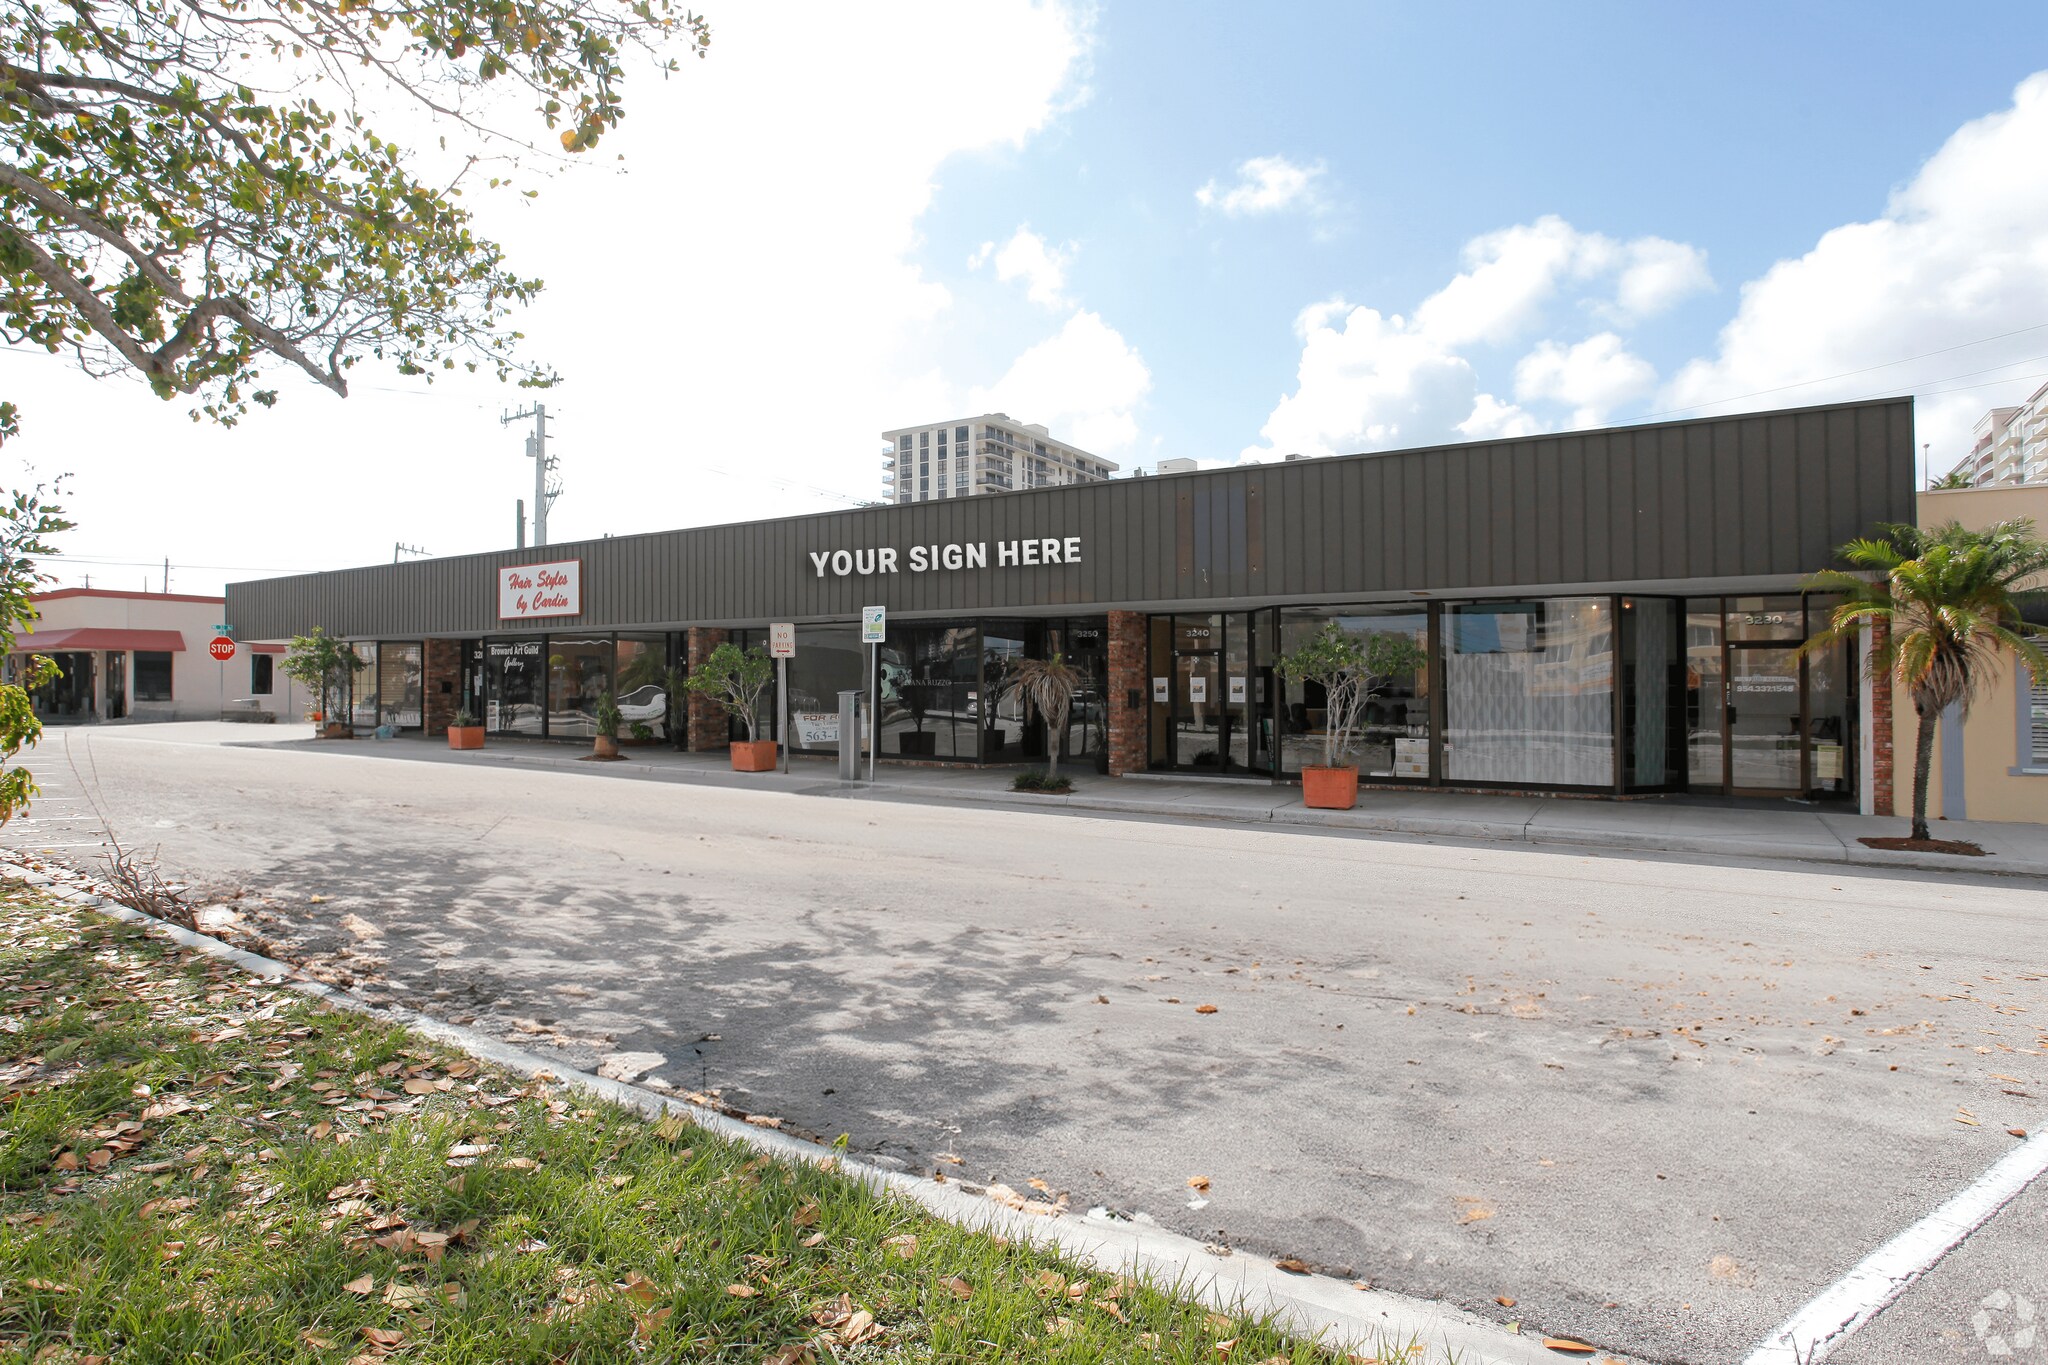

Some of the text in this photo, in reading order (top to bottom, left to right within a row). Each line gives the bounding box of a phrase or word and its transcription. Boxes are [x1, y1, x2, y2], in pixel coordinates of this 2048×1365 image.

[809, 537, 1082, 578] YOUR SIGN HERE
[508, 570, 568, 590] Hair Styles
[516, 591, 568, 614] by Cardin
[1745, 615, 1783, 625] 3230
[1186, 629, 1209, 637] 3240
[210, 644, 234, 653] STOP
[490, 645, 539, 655] Broward Art Guild
[504, 656, 524, 674] Gallery
[805, 730, 838, 741] 563-1
